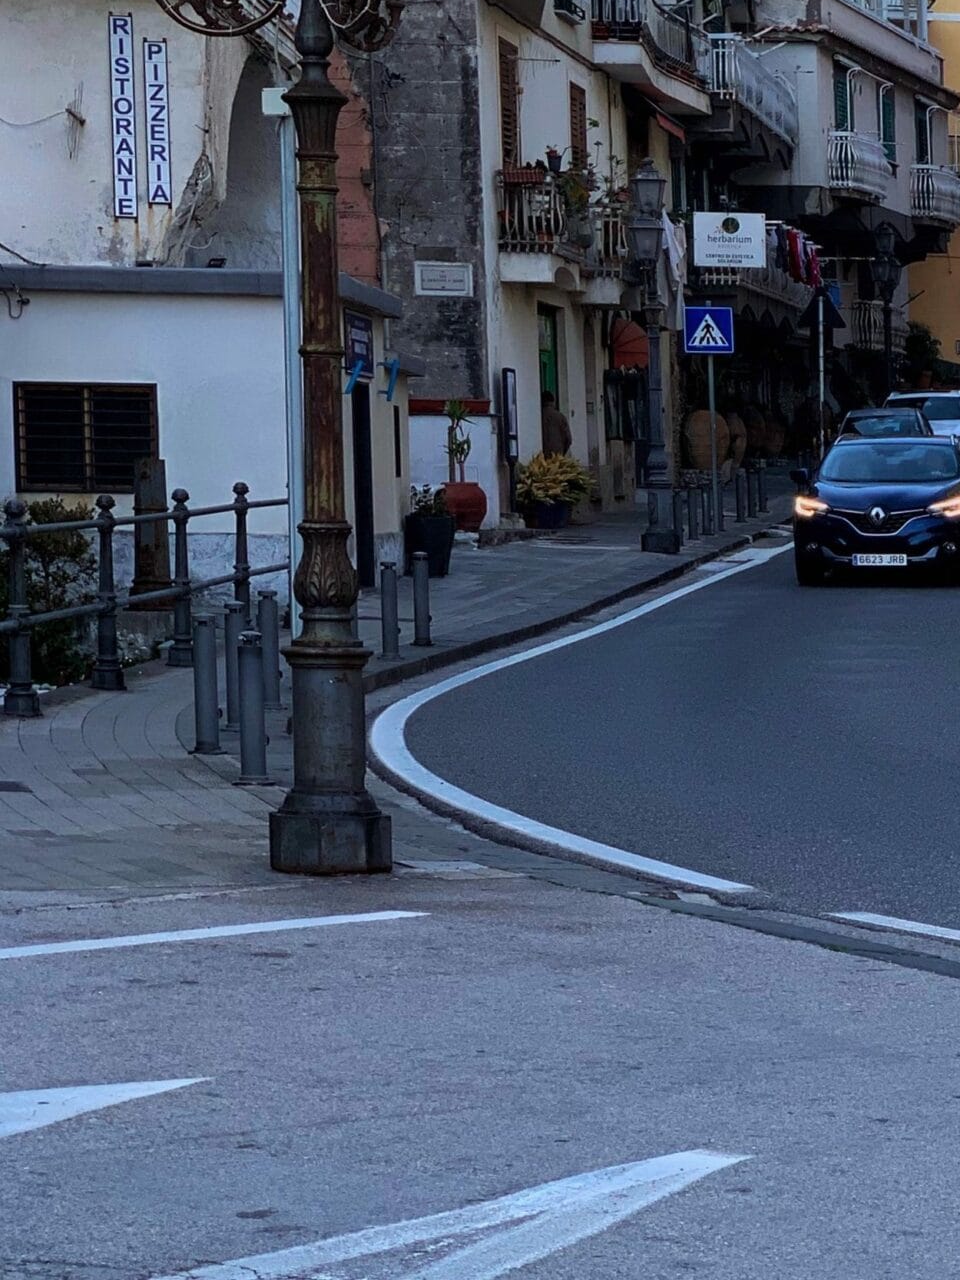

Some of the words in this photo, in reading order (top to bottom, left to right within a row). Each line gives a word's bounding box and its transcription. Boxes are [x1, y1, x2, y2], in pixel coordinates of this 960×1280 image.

[112, 17, 134, 216] RISTORANTE
[148, 43, 169, 202] PIZZERIA
[707, 234, 753, 244] herbarium
[859, 555, 884, 564] 6623
[886, 555, 905, 564] JRB
